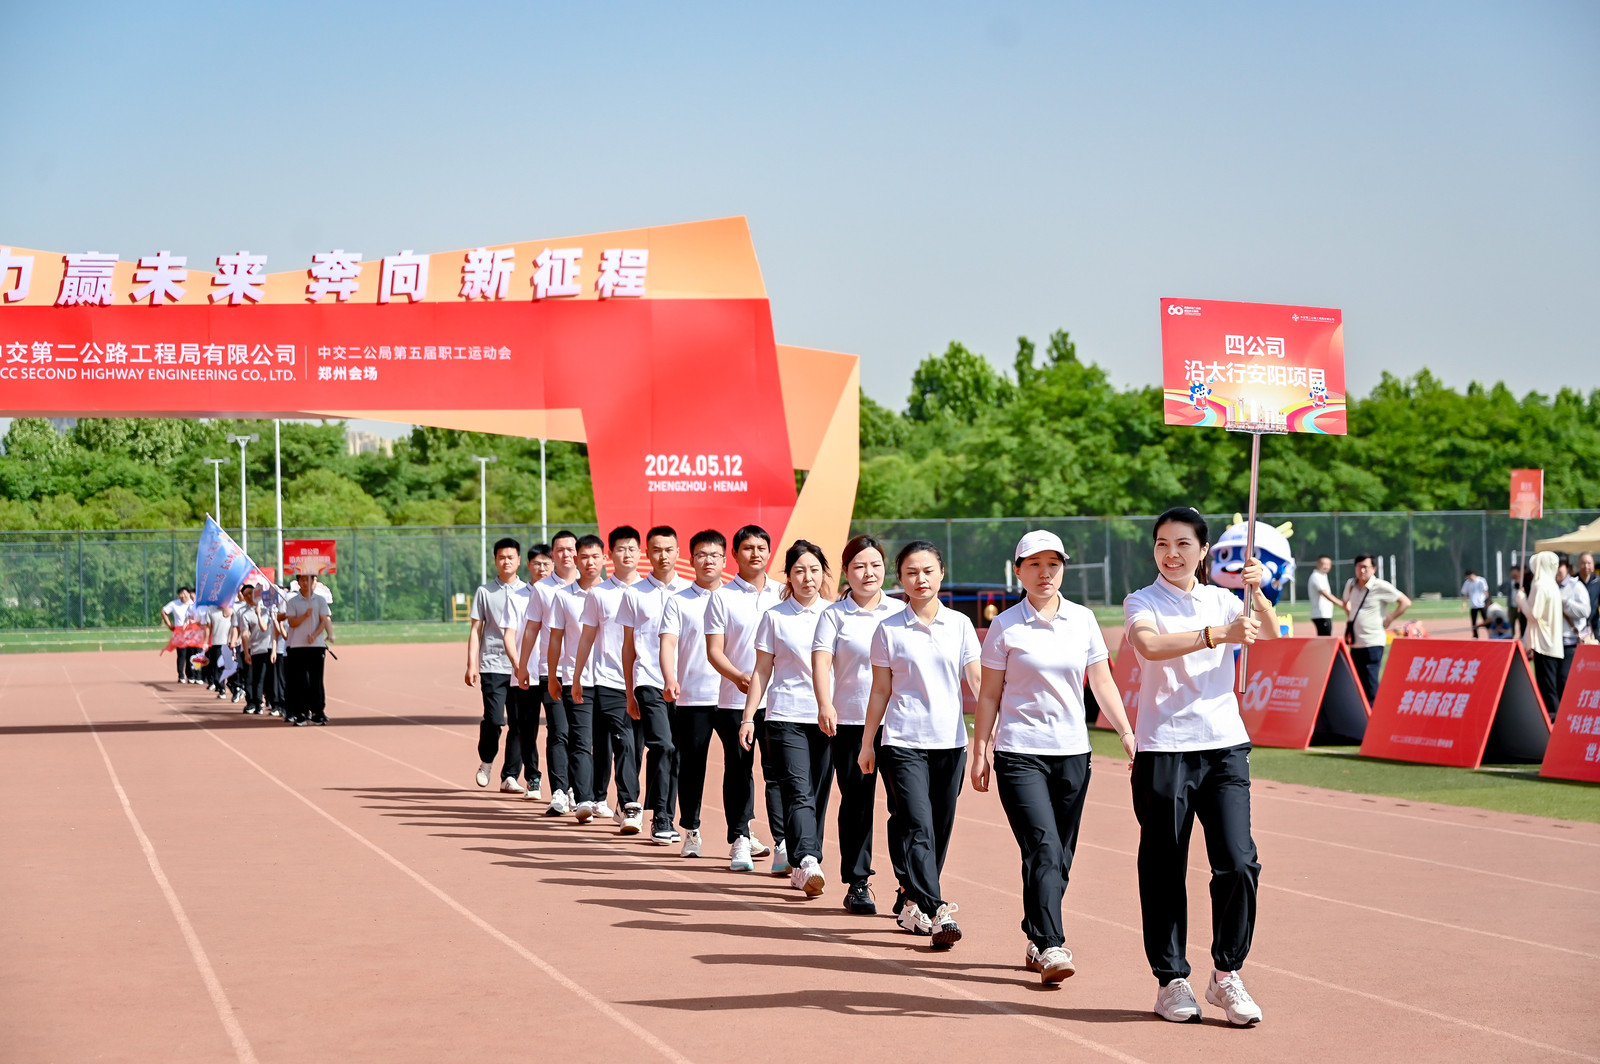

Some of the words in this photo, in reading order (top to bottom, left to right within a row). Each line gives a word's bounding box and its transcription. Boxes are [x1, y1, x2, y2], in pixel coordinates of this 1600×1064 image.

[0, 341, 296, 366] 交第二公路工程局有限公司
[317, 345, 512, 361] 中交二公局第五届职工运动会
[1225, 334, 1285, 358] 四公司
[21, 367, 77, 380] SECOND
[81, 368, 145, 380] HIGHWAY
[148, 368, 238, 380] ENGINEERING
[241, 369, 267, 382] CO.,
[270, 369, 297, 381] LTD.
[317, 365, 378, 381] 郑州会场
[1184, 359, 1326, 394] 沿太行安阳项目
[645, 454, 743, 476] 2024.05.12
[648, 480, 707, 492] ZHENGZHOU
[713, 480, 748, 492] HENAN
[1397, 689, 1470, 718] 奔向新征程
